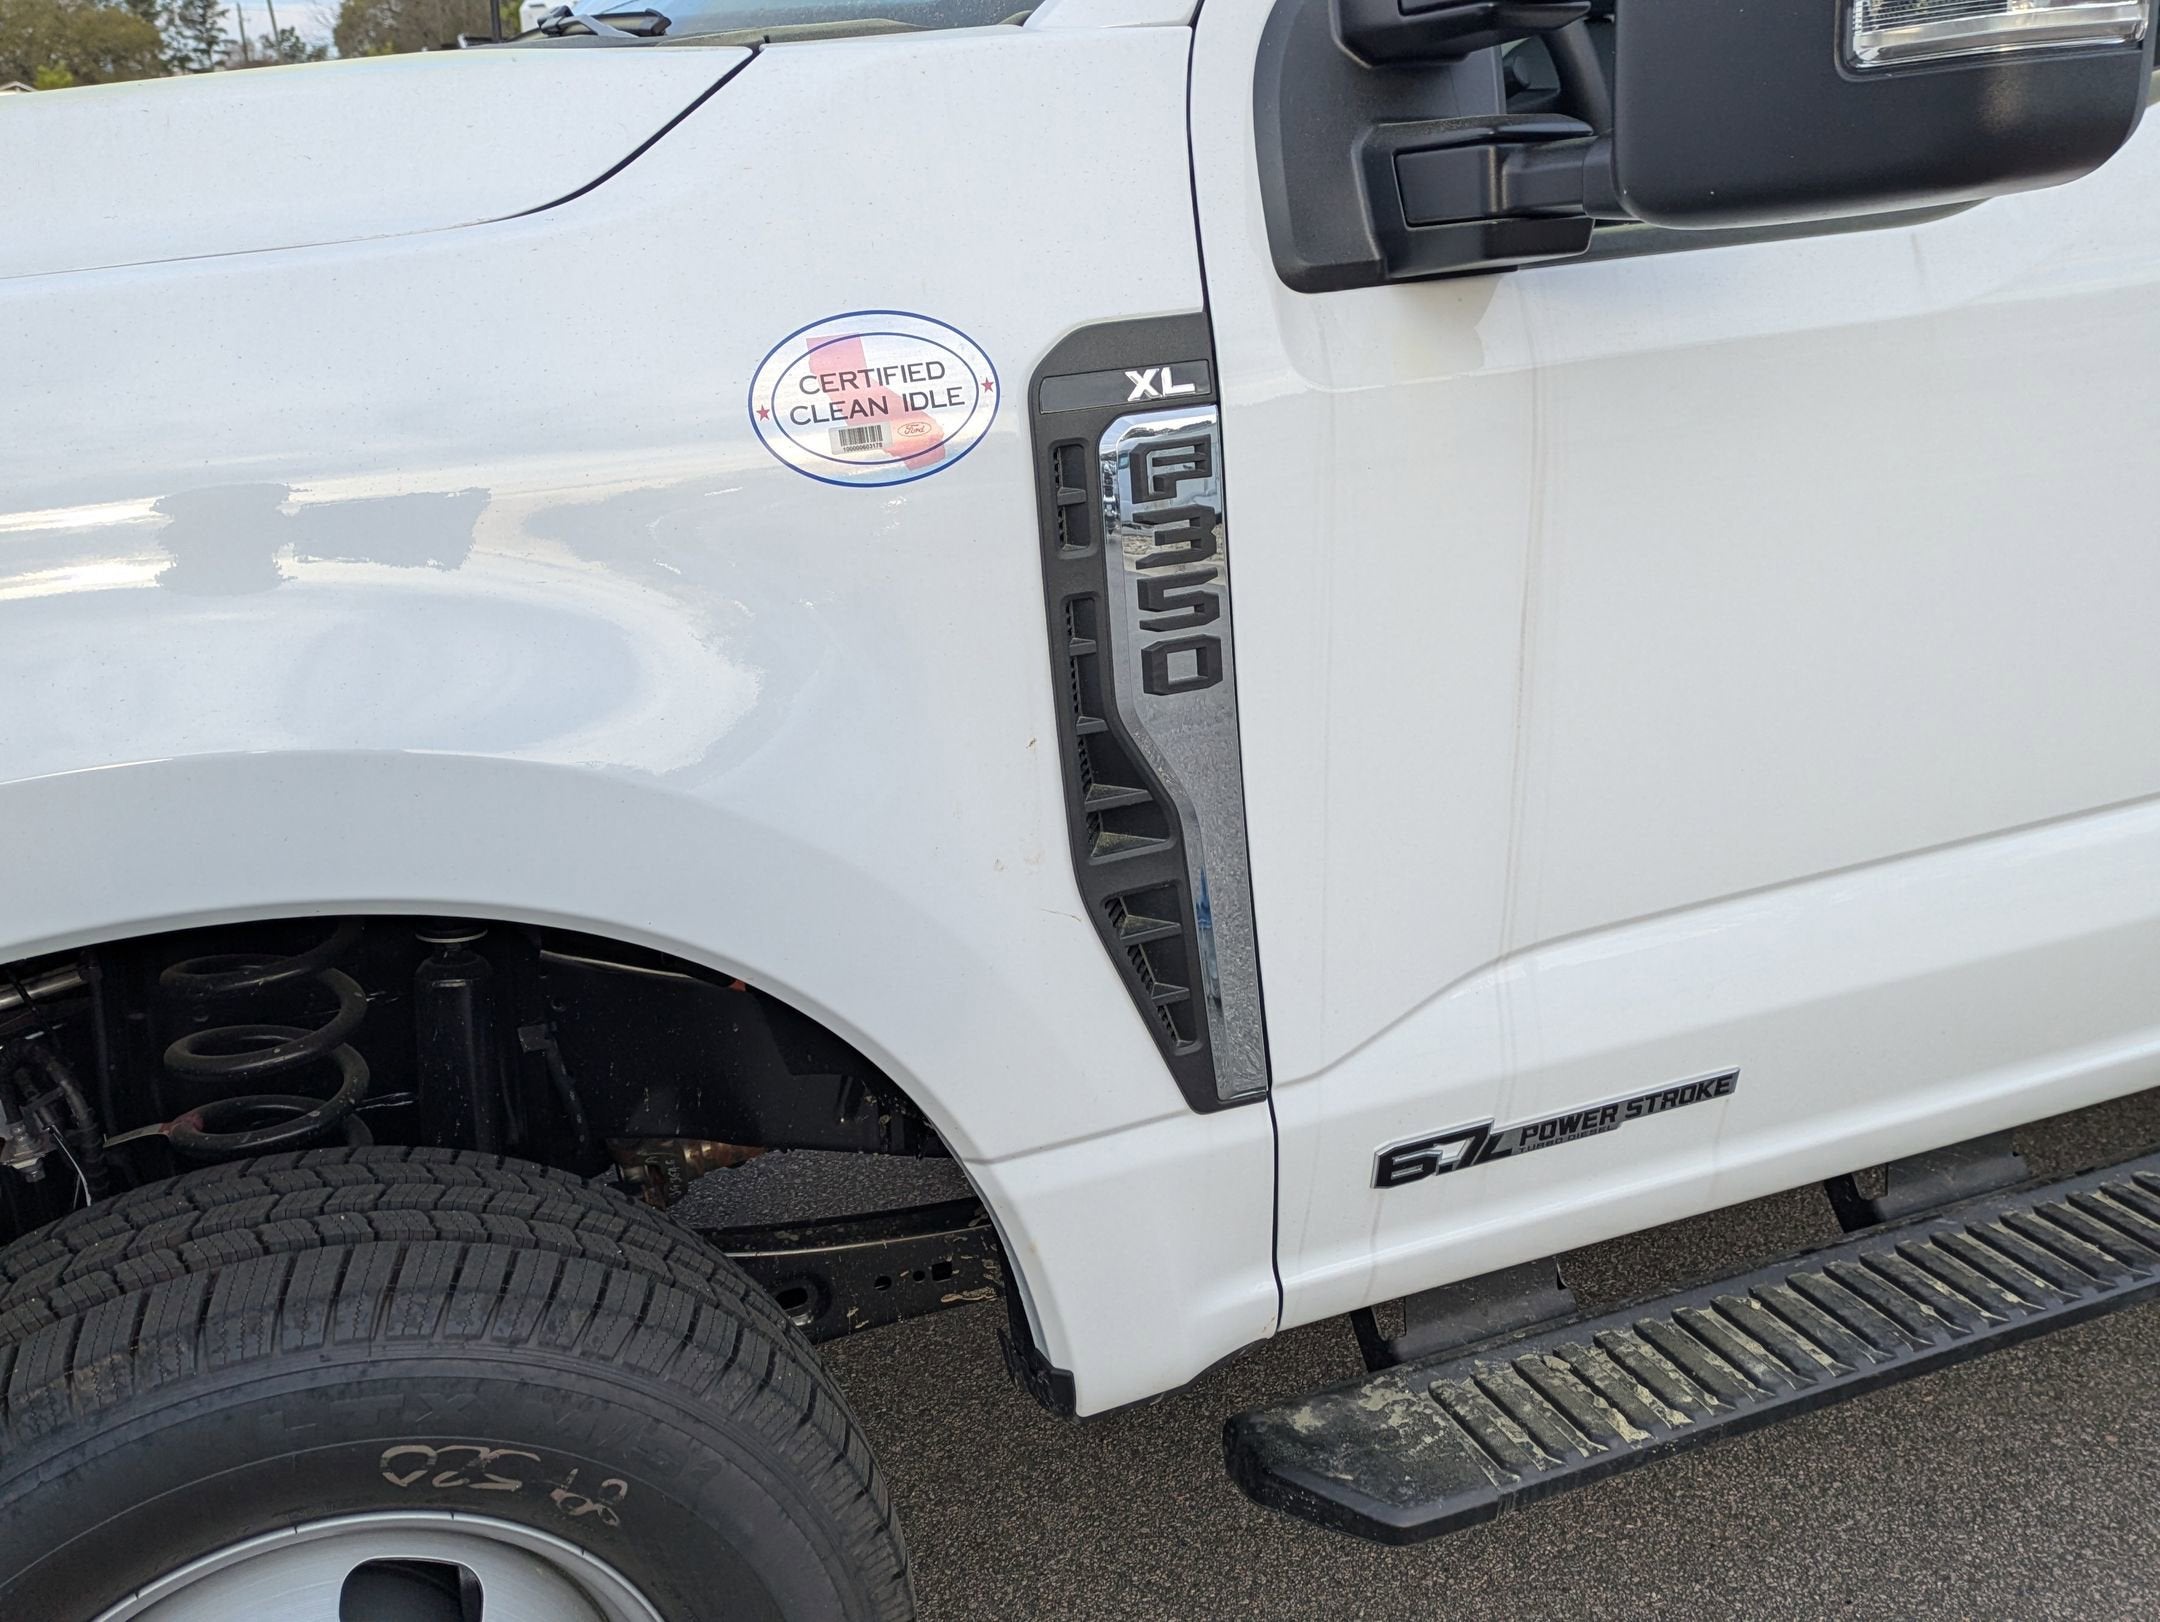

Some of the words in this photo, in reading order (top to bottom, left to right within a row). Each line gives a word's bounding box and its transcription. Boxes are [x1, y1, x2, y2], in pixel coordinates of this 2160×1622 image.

[799, 360, 946, 395] CERTIFIED
[1124, 366, 1196, 402] XL
[789, 395, 889, 426] CLEAN
[902, 386, 966, 412] IDLE
[1128, 433, 1224, 697] F350
[1518, 1100, 1618, 1147] POWER
[1624, 1074, 1736, 1120] STROKE
[1519, 1137, 1564, 1154] TURBO
[1567, 1125, 1616, 1142] DIESEL
